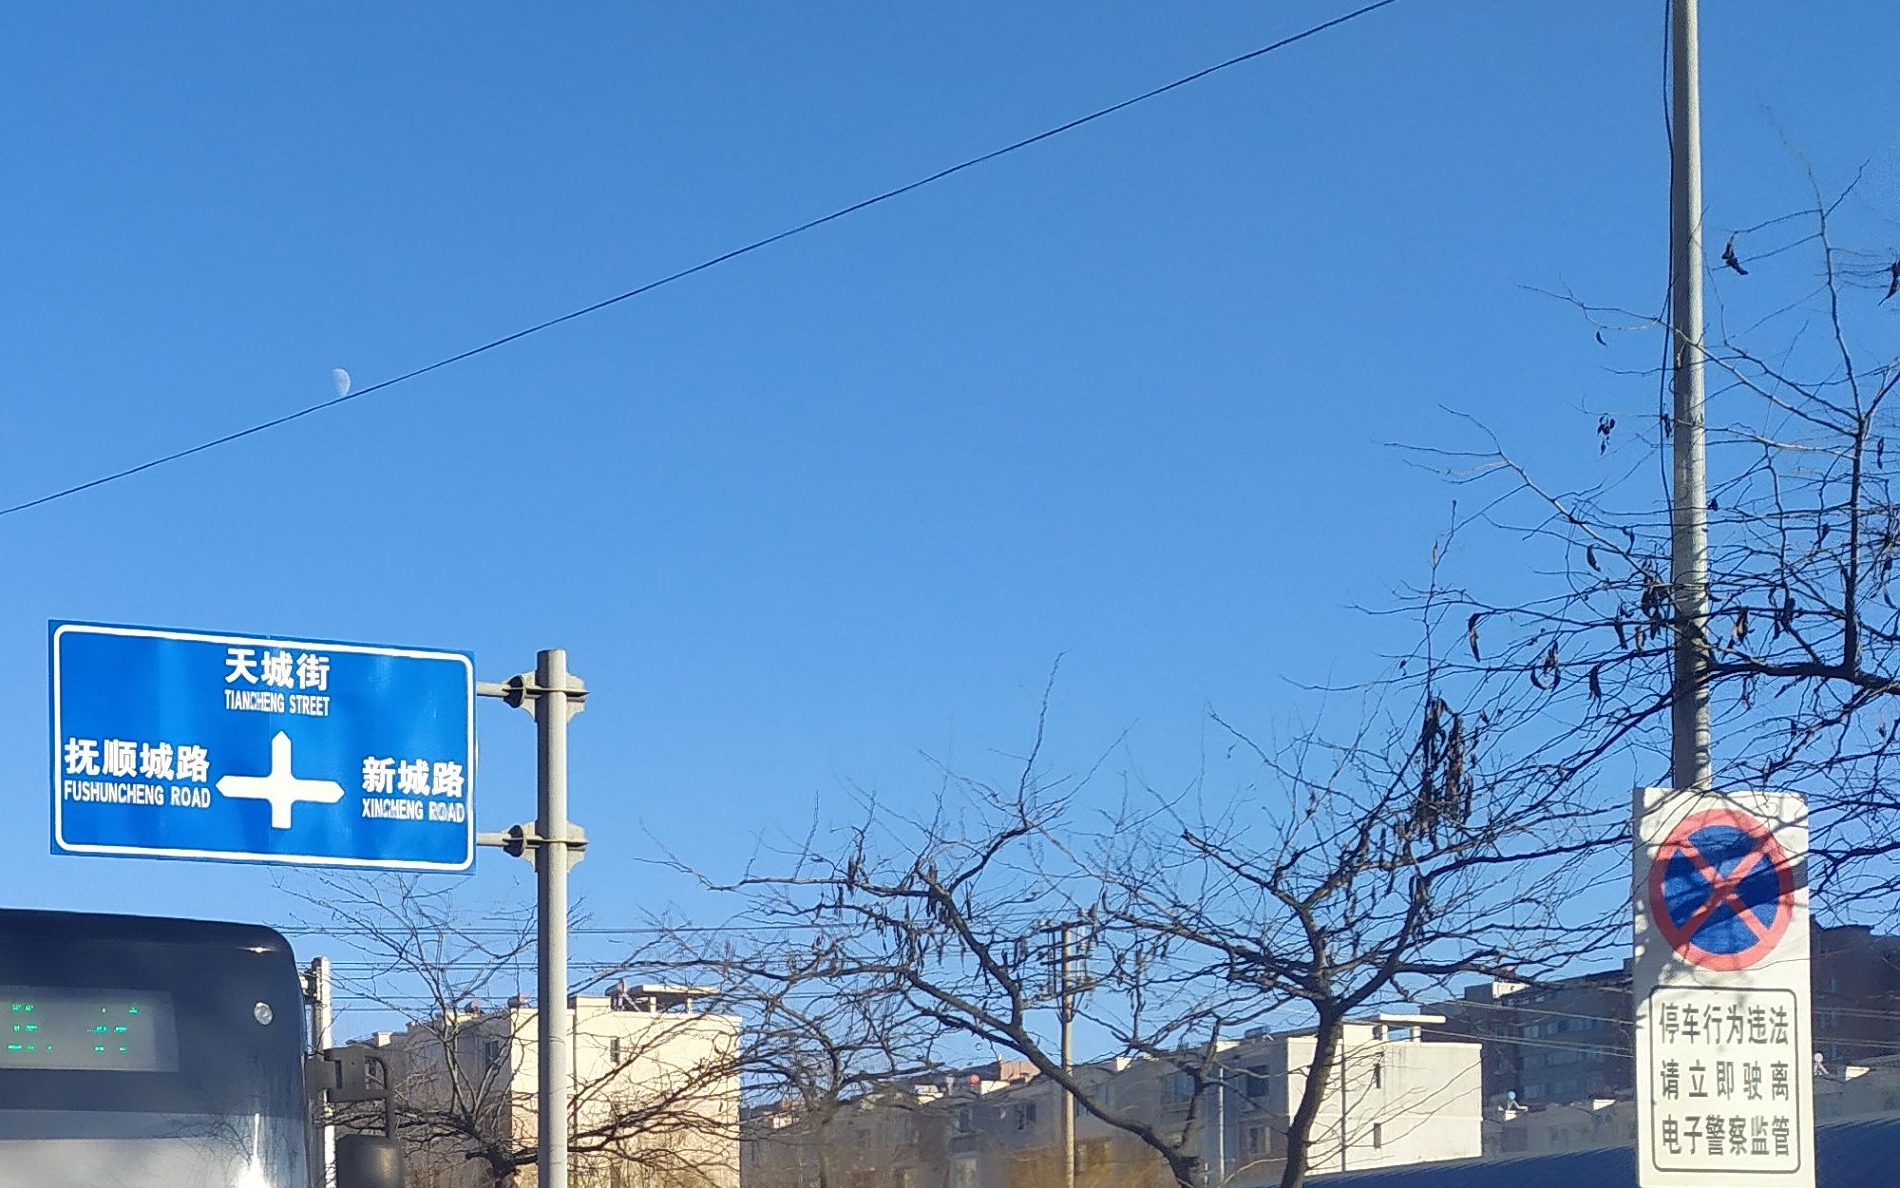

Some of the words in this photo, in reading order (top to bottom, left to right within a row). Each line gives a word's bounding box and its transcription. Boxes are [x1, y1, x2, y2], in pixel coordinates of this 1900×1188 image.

[224, 647, 331, 692] 天城街
[224, 689, 285, 713] TIANCHENG
[289, 694, 331, 717] STREET
[63, 737, 211, 783] 抚顺城路
[361, 756, 465, 798] 新城路
[63, 779, 165, 806] FUSHUNCHENG
[170, 785, 212, 809] ROAD
[361, 798, 424, 820] XINCHENG
[428, 801, 466, 823] ROAD
[1658, 1001, 1790, 1046] 停车行为违法
[1659, 1058, 1790, 1102] 请立即驶离
[1661, 1113, 1791, 1157] 电子警察监管
